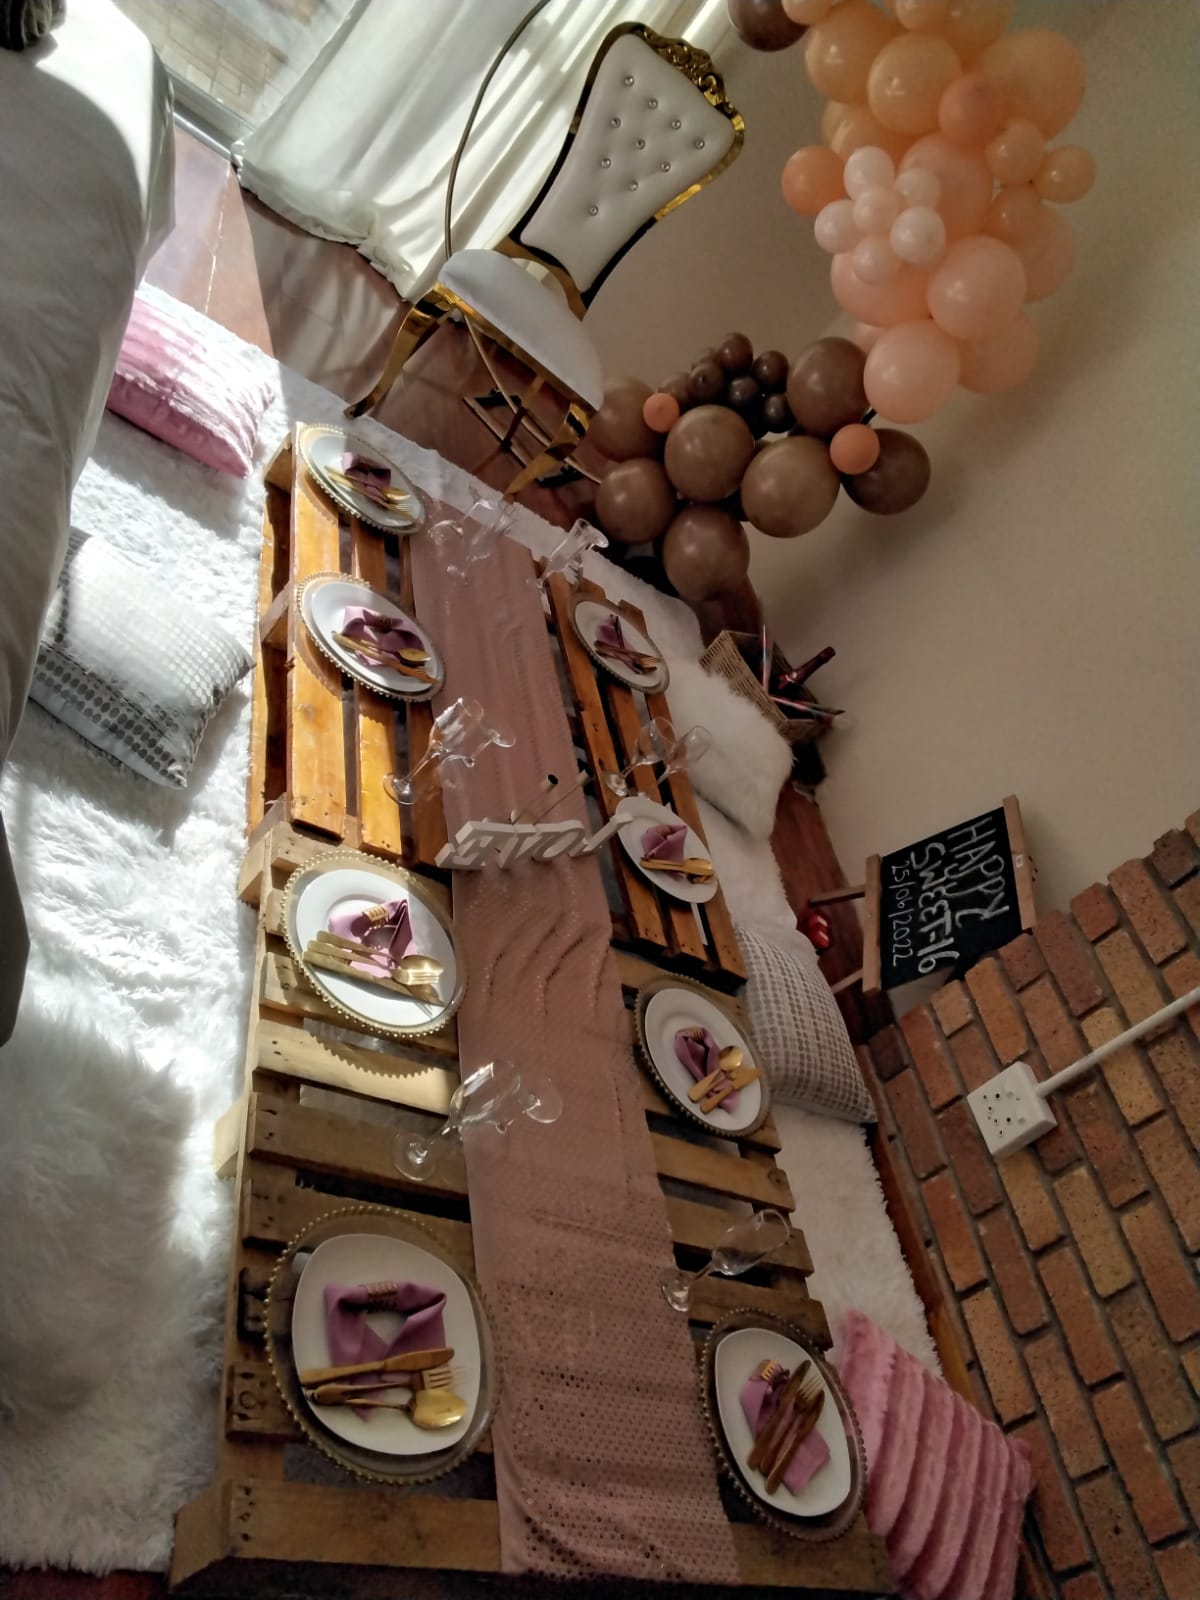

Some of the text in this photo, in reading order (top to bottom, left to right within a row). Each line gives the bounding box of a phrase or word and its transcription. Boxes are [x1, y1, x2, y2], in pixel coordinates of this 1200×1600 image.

[888, 860, 917, 967] 25/06/2022
[910, 841, 960, 974] SWEET-16
[943, 816, 1010, 928] HAPPY
